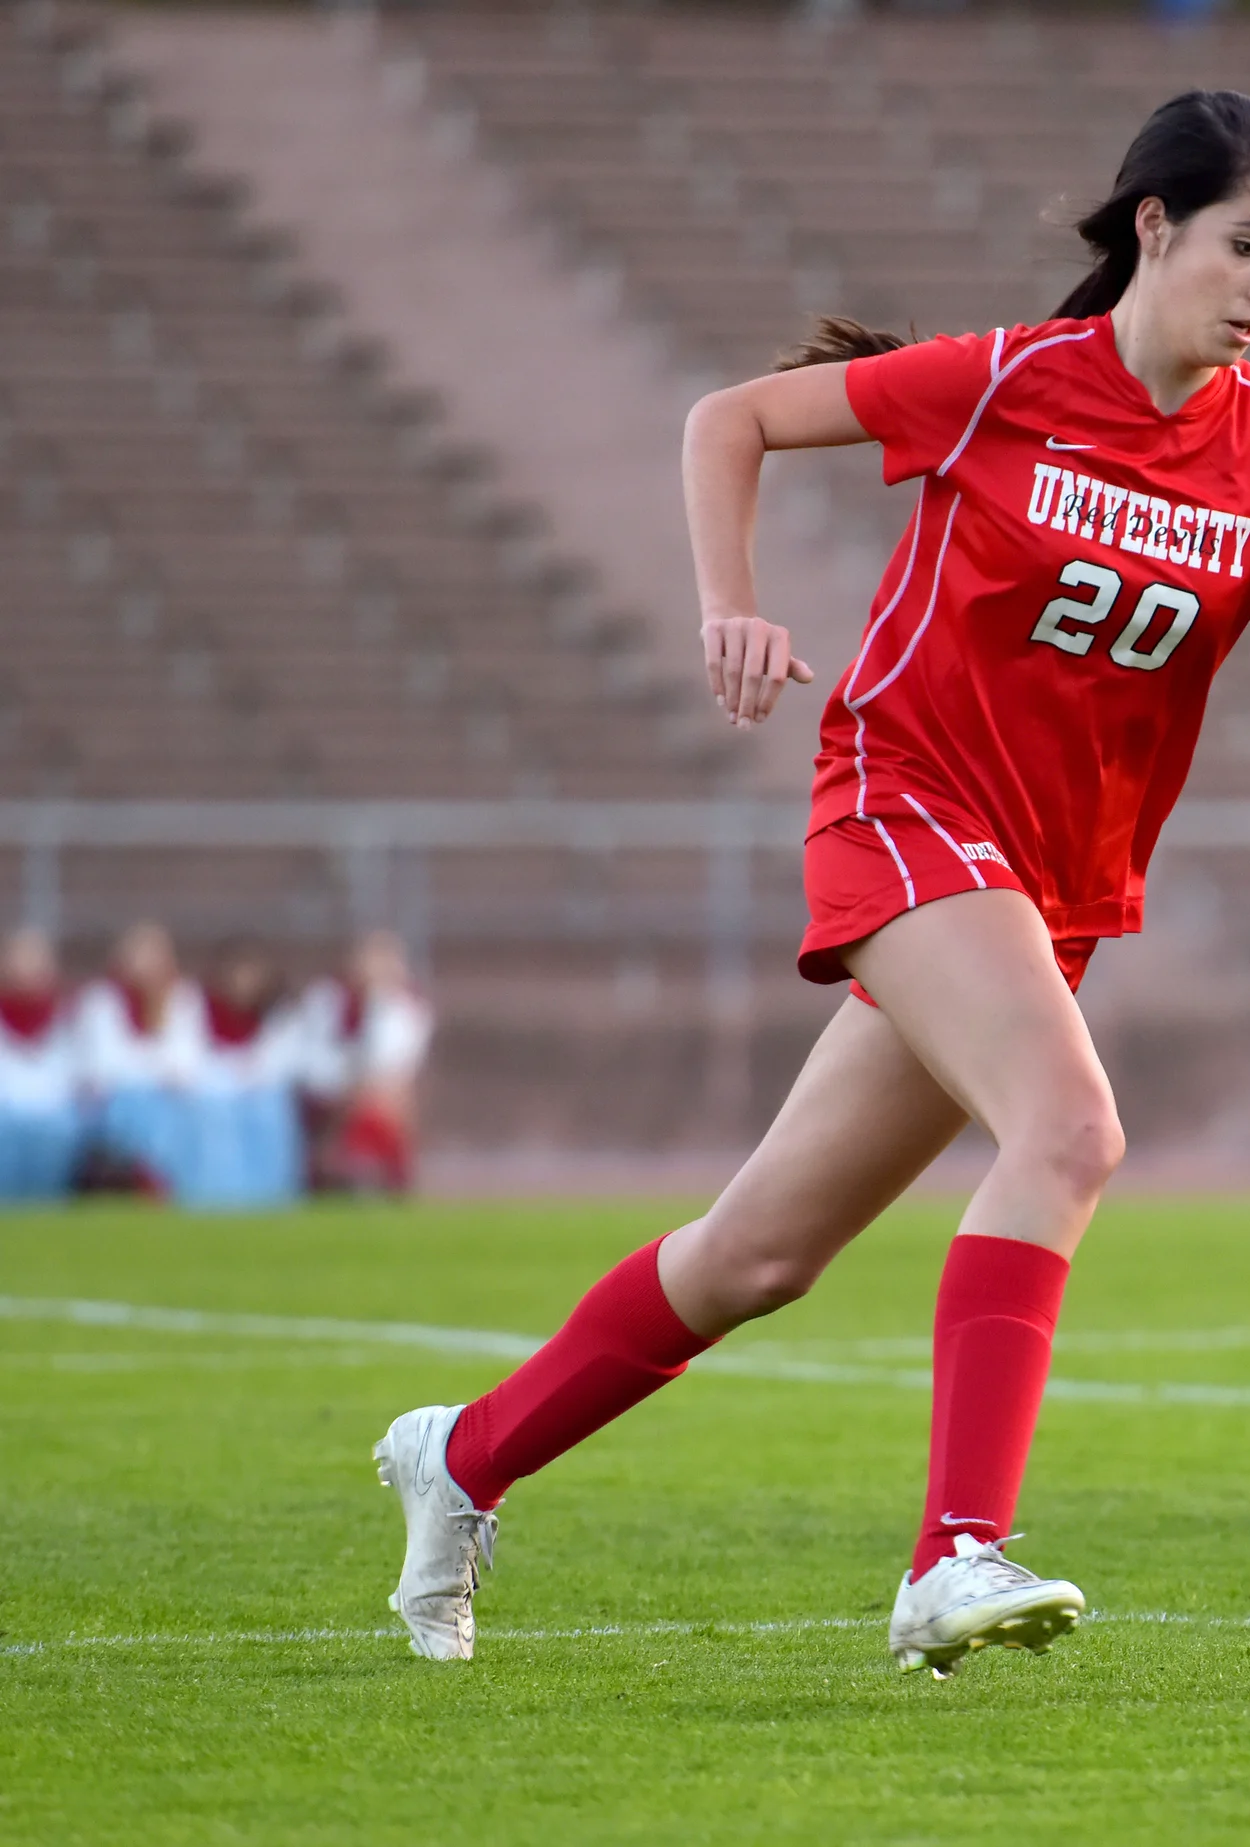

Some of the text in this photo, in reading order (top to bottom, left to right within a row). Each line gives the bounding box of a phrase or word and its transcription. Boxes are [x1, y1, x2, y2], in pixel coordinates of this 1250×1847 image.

[1063, 493, 1221, 556] Red Devils
[1030, 559, 1201, 671] 20
